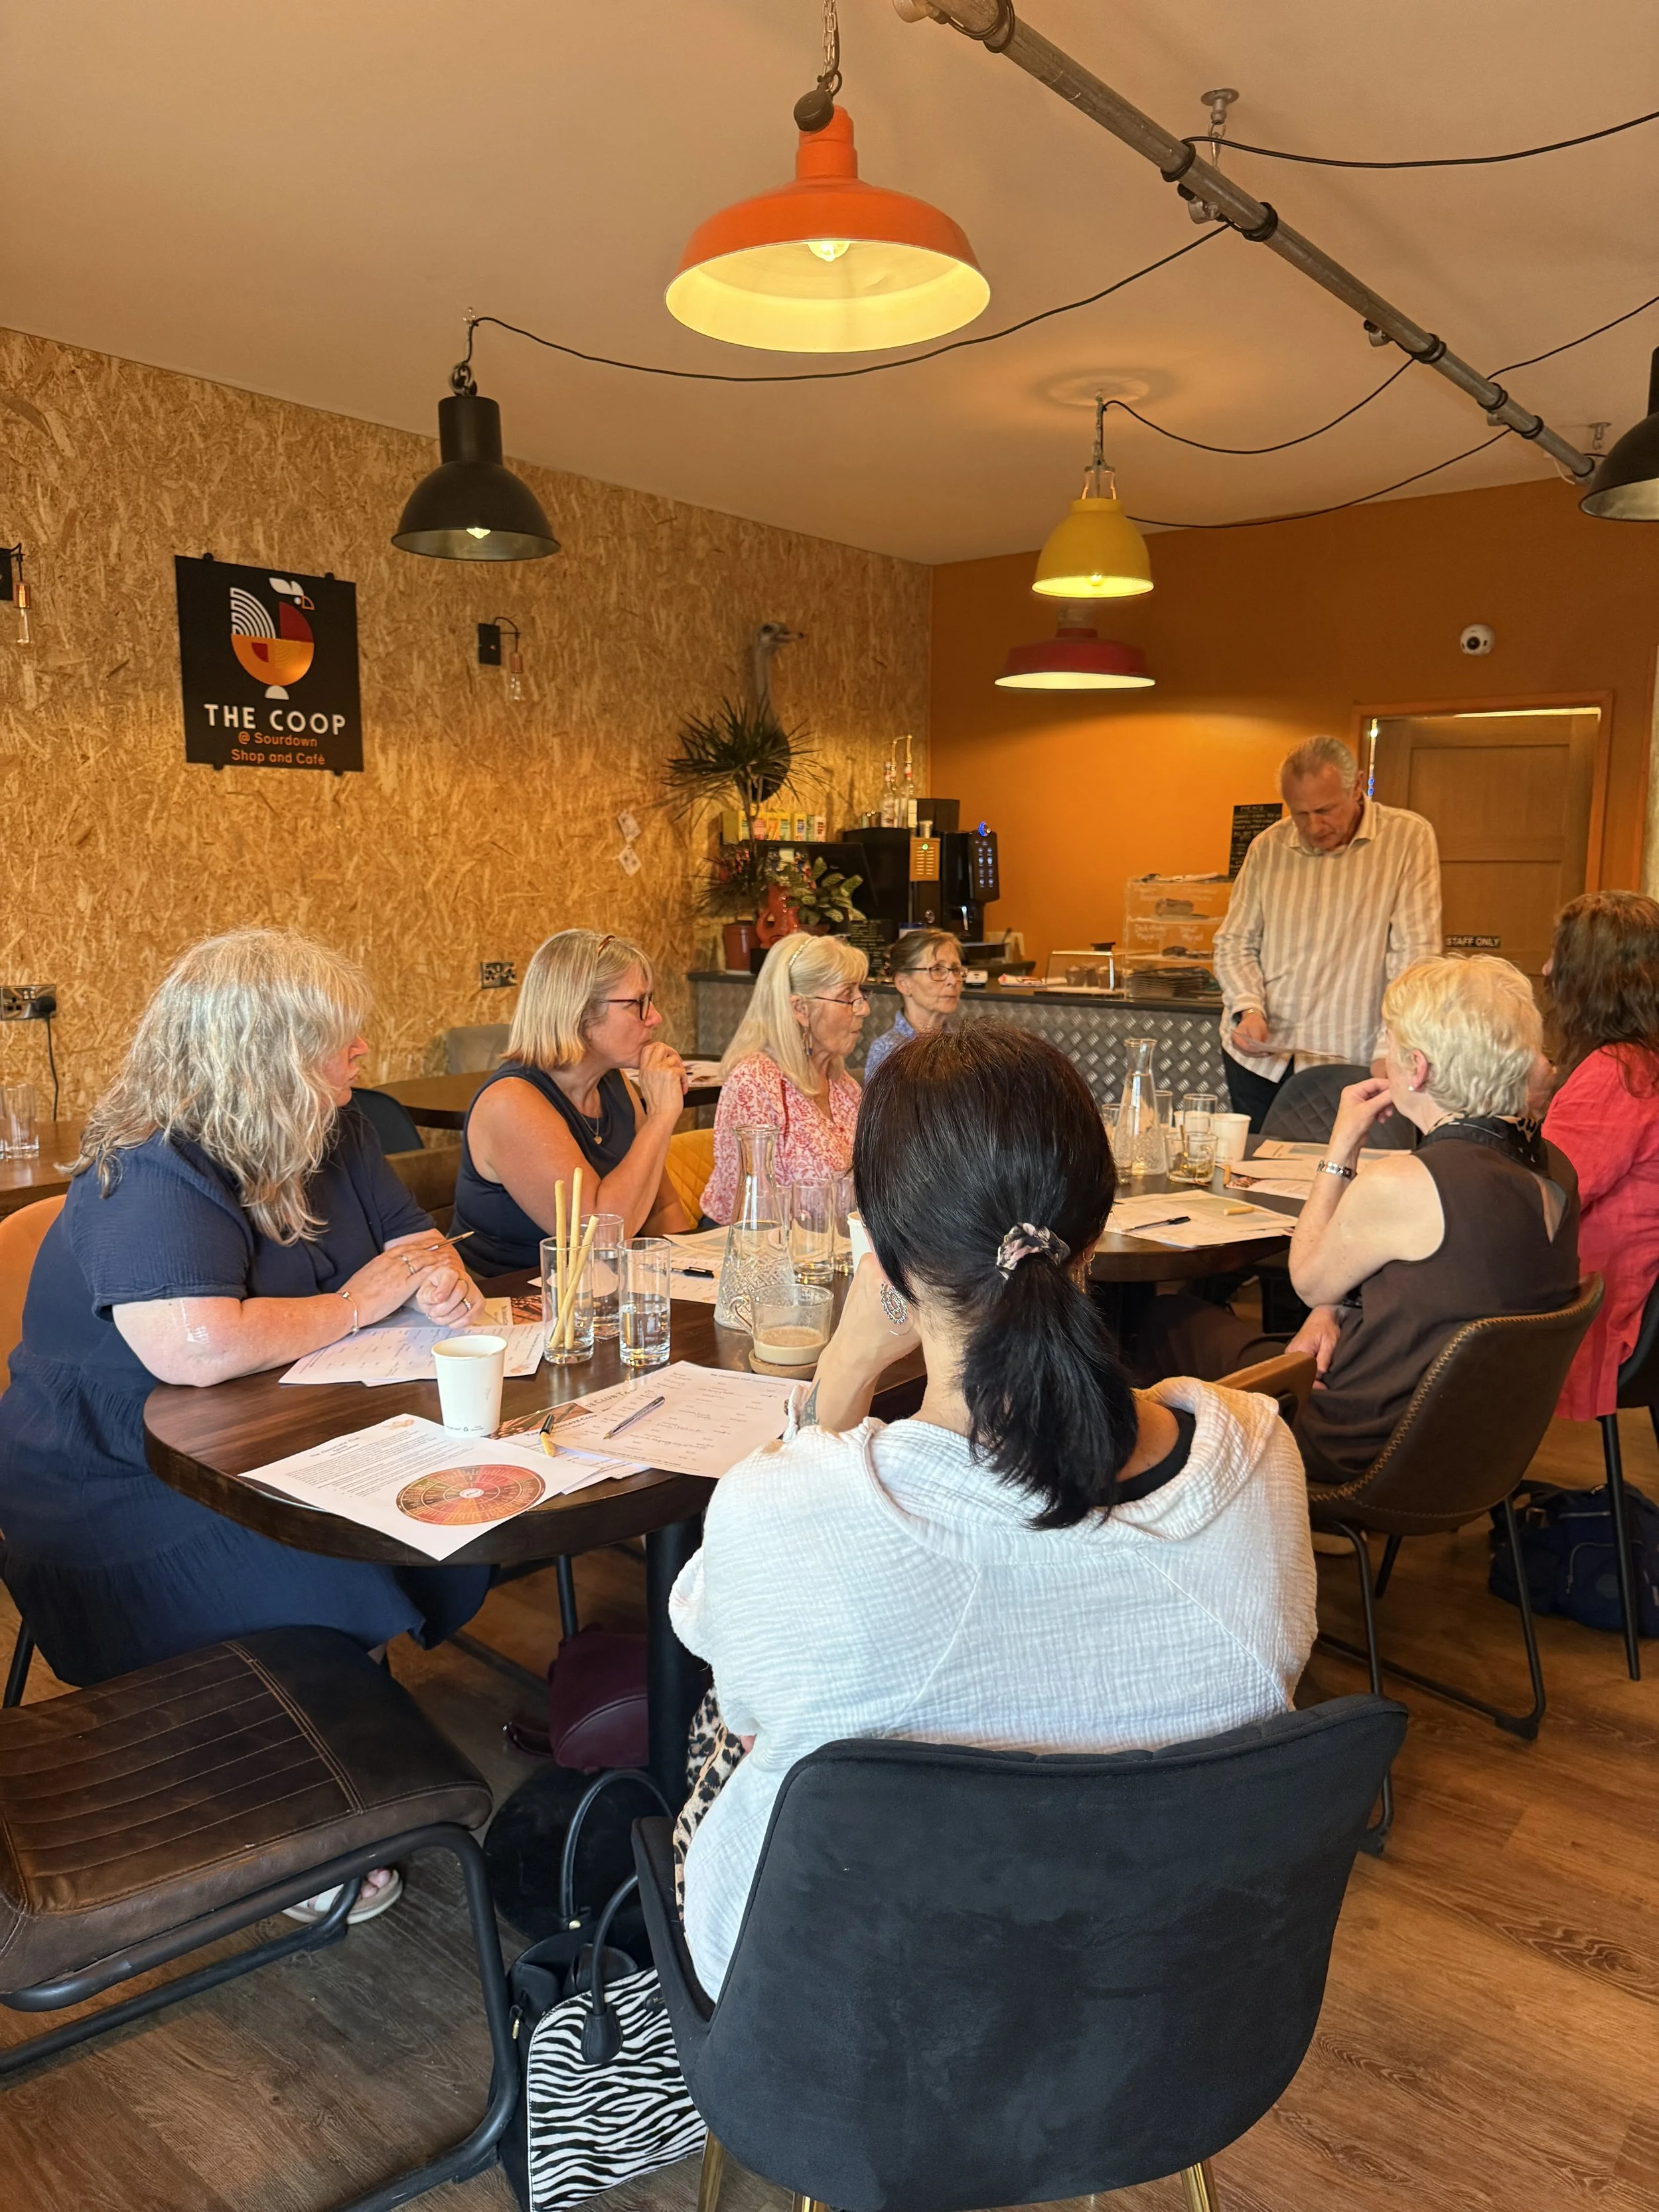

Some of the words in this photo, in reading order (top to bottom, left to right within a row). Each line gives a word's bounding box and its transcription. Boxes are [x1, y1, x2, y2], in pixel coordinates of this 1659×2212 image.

[204, 703, 256, 729] THE
[269, 709, 346, 735] COOP
[238, 731, 250, 745] @
[254, 732, 318, 747] Sourdown
[231, 749, 265, 764] Shop
[269, 752, 293, 763] and
[296, 753, 325, 765] Café
[1446, 936, 1473, 946] STAFF
[1475, 936, 1500, 946] ONLY
